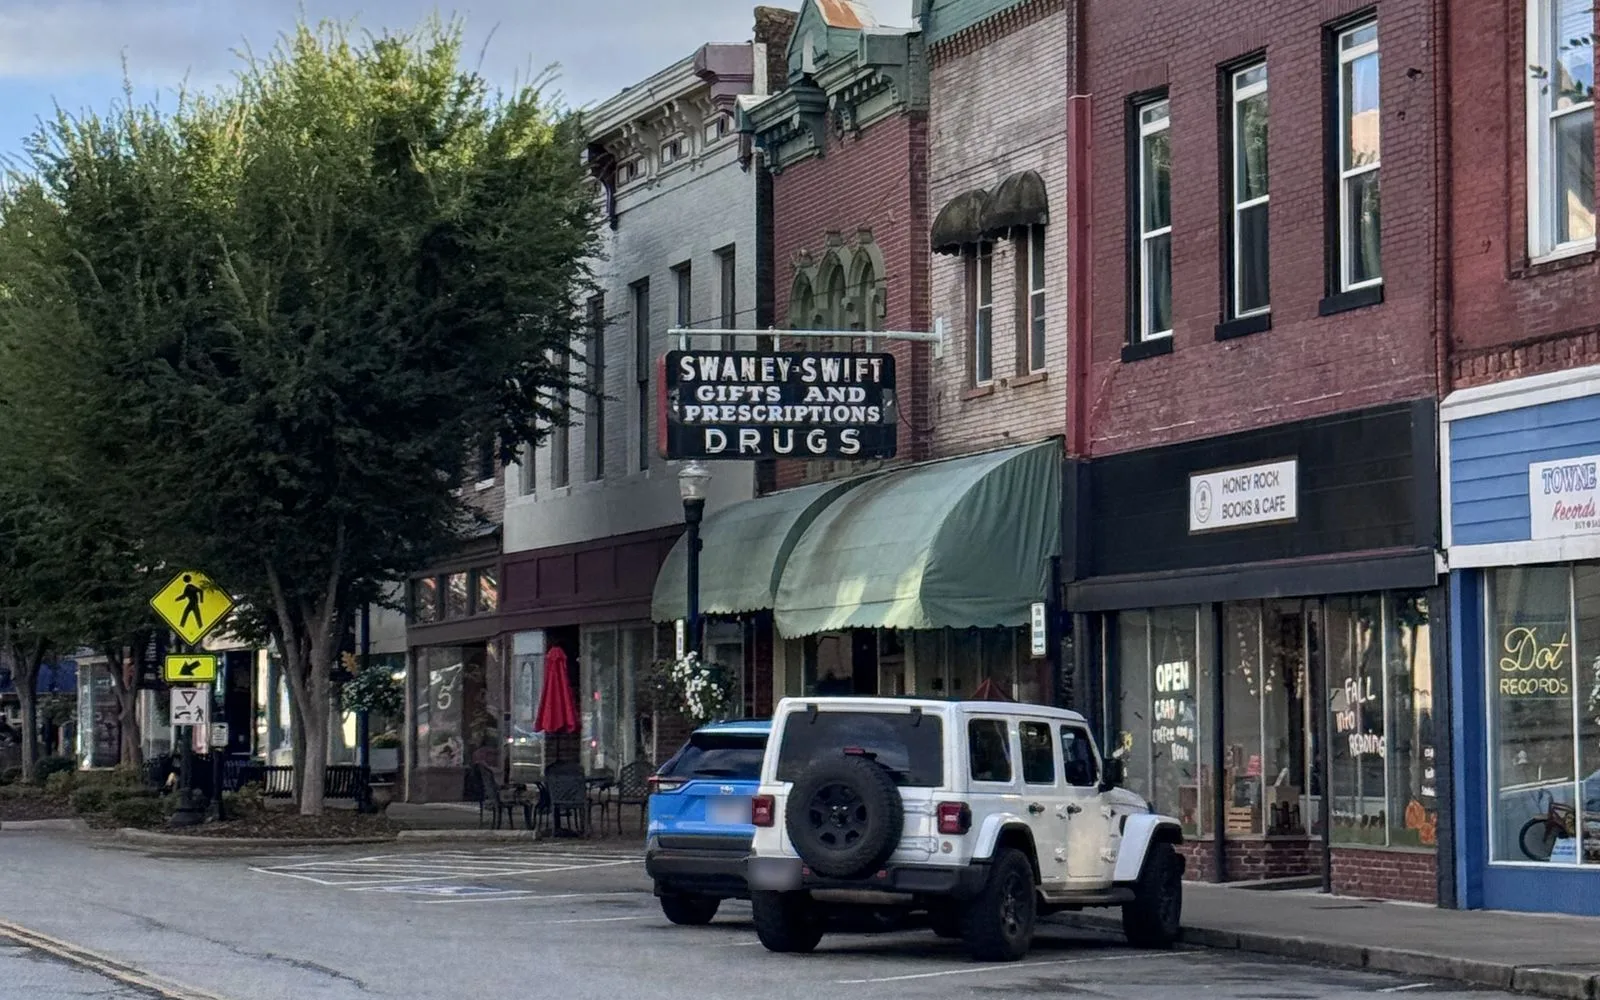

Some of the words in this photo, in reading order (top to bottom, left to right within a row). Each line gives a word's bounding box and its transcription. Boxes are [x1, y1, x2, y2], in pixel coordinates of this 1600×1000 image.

[680, 355, 883, 383] SWANEY-SWIFT
[697, 385, 782, 402] GIFTS
[804, 386, 866, 403] AND
[684, 405, 881, 423] PRESCRIPTIONS
[705, 428, 861, 455] DRUGS
[1222, 475, 1252, 494] HONEY
[1254, 470, 1279, 489] ROCK
[1542, 463, 1597, 495] TOWNE
[1222, 499, 1252, 519] BOOKS
[1254, 498, 1260, 514] &
[1262, 495, 1286, 513] CAFE
[1552, 496, 1596, 521] Records
[1500, 627, 1568, 671] Dot
[1156, 661, 1189, 692] OPEN
[1500, 677, 1568, 695] RECORDS
[1345, 676, 1376, 705] FALL
